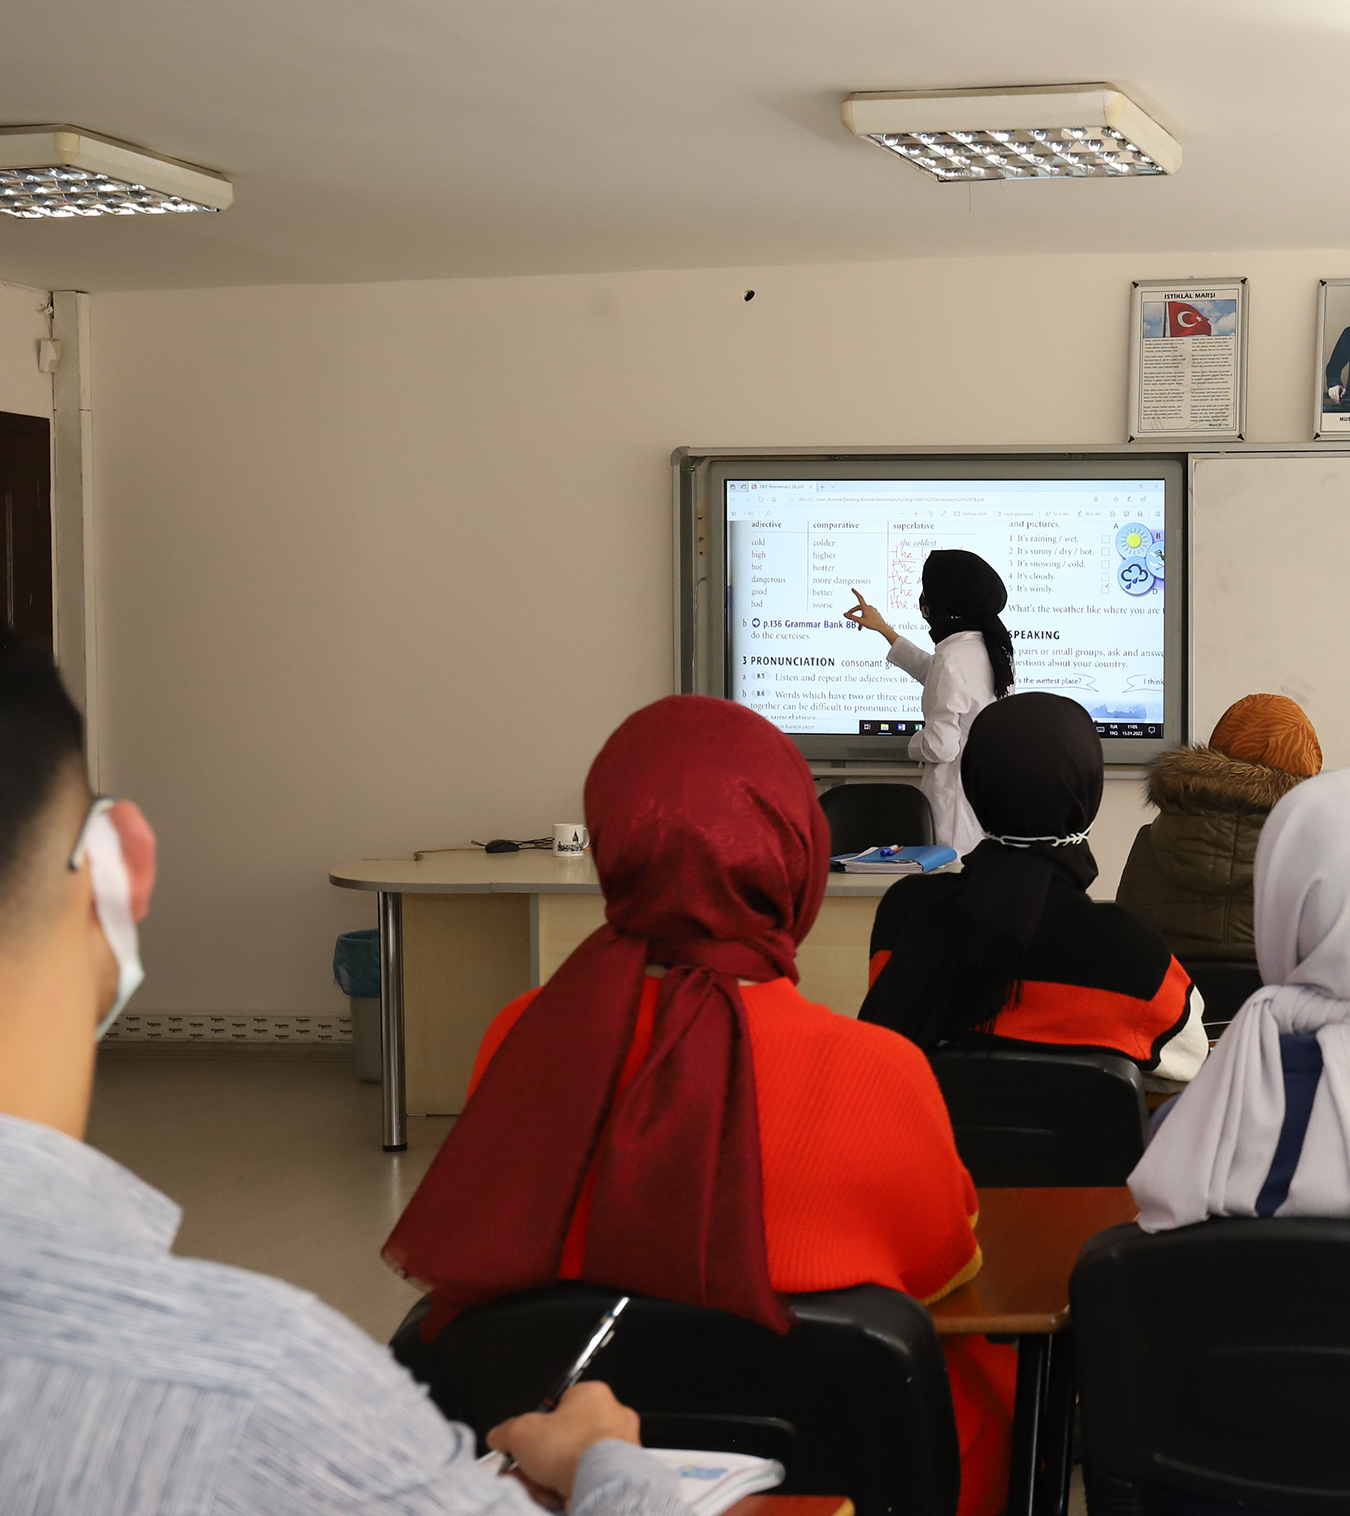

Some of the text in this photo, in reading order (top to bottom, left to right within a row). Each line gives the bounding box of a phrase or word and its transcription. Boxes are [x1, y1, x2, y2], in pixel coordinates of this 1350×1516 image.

[752, 521, 782, 529] adjective
[812, 522, 860, 530] comparative
[892, 522, 935, 530] superlative
[1027, 521, 1061, 529] pictures.
[1030, 535, 1057, 544] raining
[752, 551, 766, 560] high
[812, 552, 836, 560] higher
[1060, 548, 1072, 556] dry
[1030, 560, 1060, 569] snowing
[751, 576, 786, 584] dangerous
[834, 577, 871, 586] dangerous
[1030, 573, 1056, 581] cloudy.
[751, 588, 768, 597] good
[1030, 585, 1054, 593] windy.
[1008, 604, 1036, 612] What's
[1086, 606, 1100, 614] like
[742, 619, 747, 627] b
[764, 620, 782, 629] p.136
[785, 620, 820, 628] Grammar
[824, 620, 844, 628] Bank
[898, 622, 918, 630] rules
[1008, 630, 1060, 640] SPEAKING
[1019, 647, 1038, 657] pairs
[1075, 650, 1106, 658] groups,
[1123, 649, 1138, 657] and
[742, 656, 747, 665] 3
[750, 656, 835, 666] PRONUNCIATION
[1048, 659, 1070, 667] about
[1094, 662, 1128, 670] country.
[775, 673, 798, 682] Listen
[801, 674, 816, 682] and
[818, 675, 842, 684] repeat
[844, 674, 858, 682] the
[860, 674, 898, 684] adjectives
[742, 690, 747, 698] b
[775, 691, 800, 699] Words
[803, 691, 826, 699] which
[828, 692, 846, 700] have
[877, 692, 897, 700] three
[750, 702, 780, 711] together
[799, 702, 808, 710] be
[810, 702, 841, 711] difficult
[854, 705, 899, 714] pronounce.
